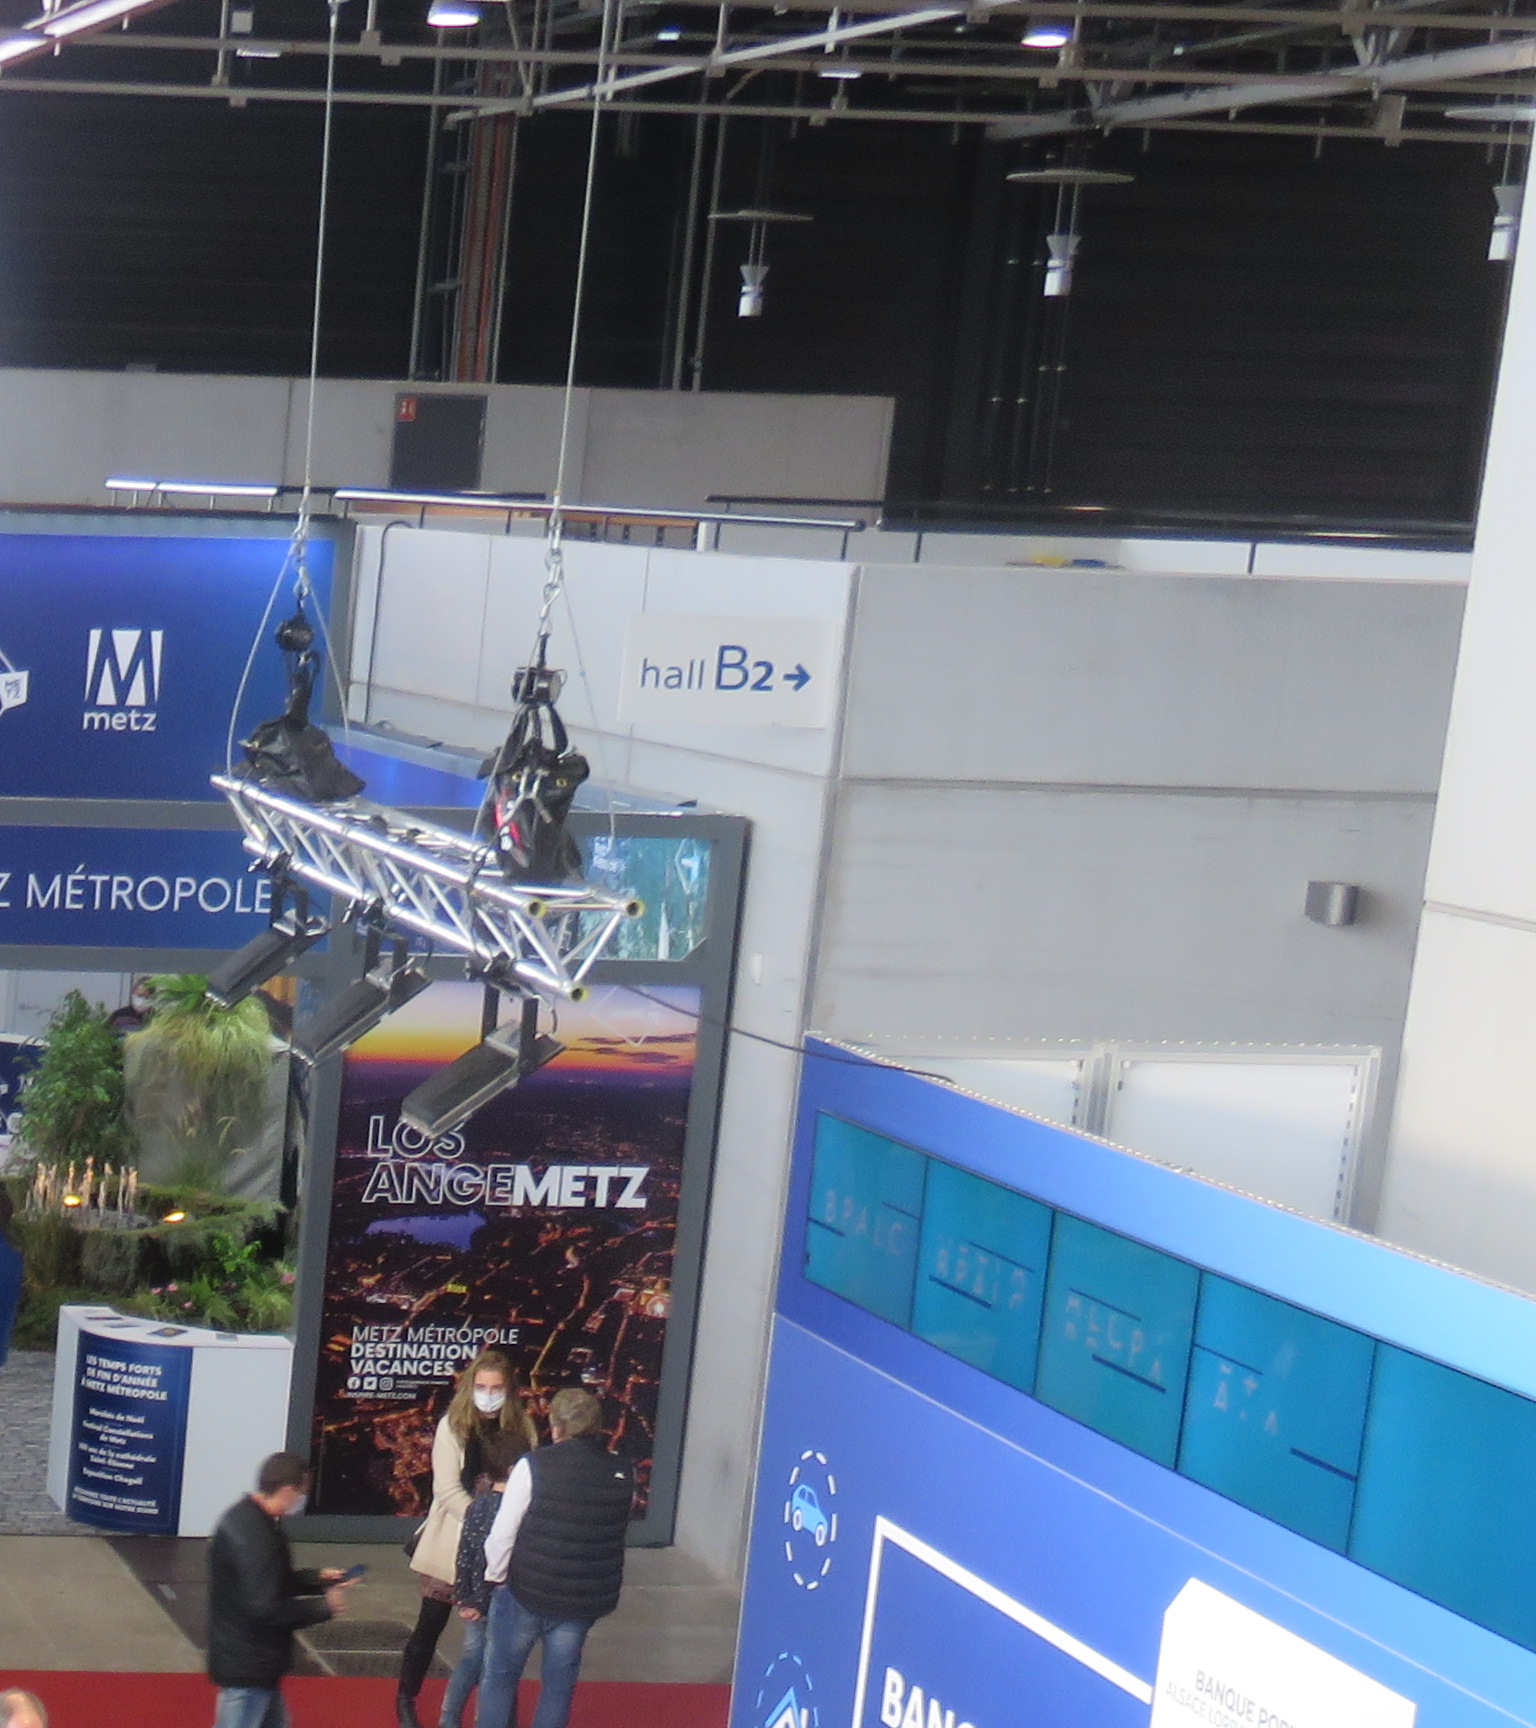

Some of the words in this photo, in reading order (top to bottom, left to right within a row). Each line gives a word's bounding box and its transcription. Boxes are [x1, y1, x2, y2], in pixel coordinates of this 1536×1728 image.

[640, 657, 705, 690] hall
[715, 645, 774, 692] B2
[82, 711, 158, 732] metz
[27, 863, 272, 914] MÉTROPOLE
[352, 1325, 403, 1342] METZ
[406, 1323, 520, 1345] MÉTROPOLE
[350, 1342, 477, 1360] DESTINATION
[98, 1357, 127, 1372] TEMPS
[129, 1361, 162, 1376] FORTS
[350, 1359, 456, 1376] VACANCES
[86, 1380, 106, 1392] METZ
[107, 1382, 168, 1401] MÉTROPOLE
[1165, 1681, 1207, 1720] ALSACE
[1195, 1669, 1255, 1724] BANQUE
